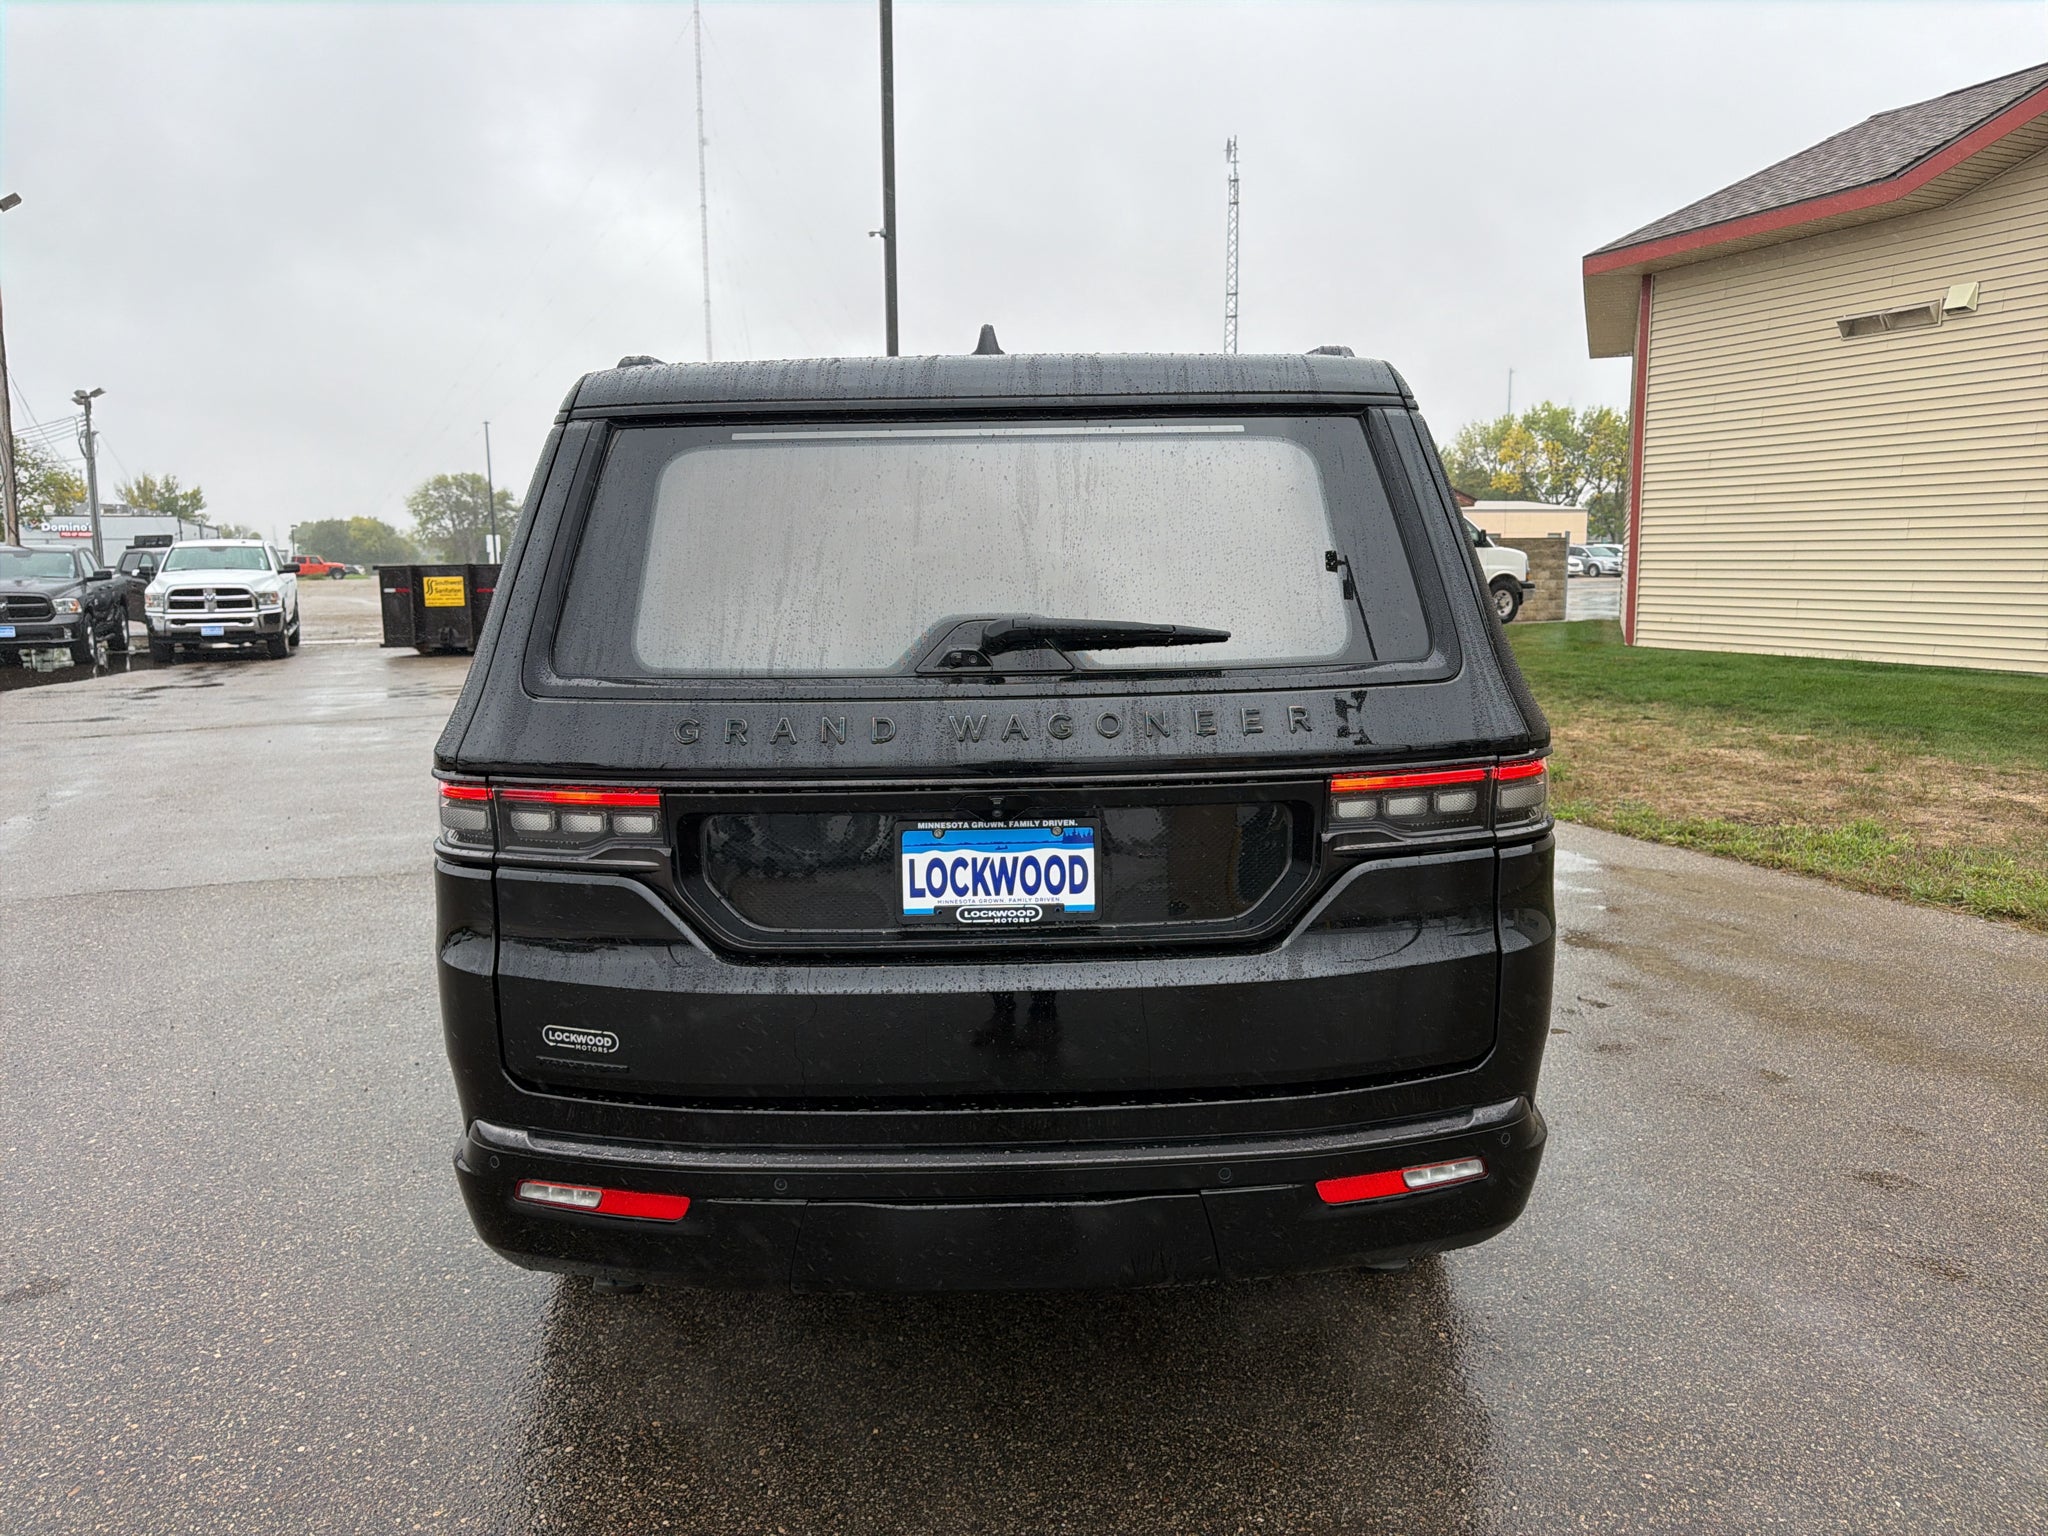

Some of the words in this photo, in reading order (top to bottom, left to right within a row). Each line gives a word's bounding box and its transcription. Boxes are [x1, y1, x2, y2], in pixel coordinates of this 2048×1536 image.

[673, 716, 897, 745] GRAND
[949, 704, 1313, 743] WAGONEER
[917, 821, 969, 829] MINNESOTA
[971, 821, 1007, 829] GROWN.
[1009, 819, 1039, 827] FAMILY
[1042, 819, 1078, 827] DRIVEN.
[908, 854, 1089, 898] LOCKWOOD
[964, 909, 1036, 918] LOCKWOOD
[548, 1030, 612, 1046] LOCKWOOD
[575, 1044, 608, 1053] MOTORS
